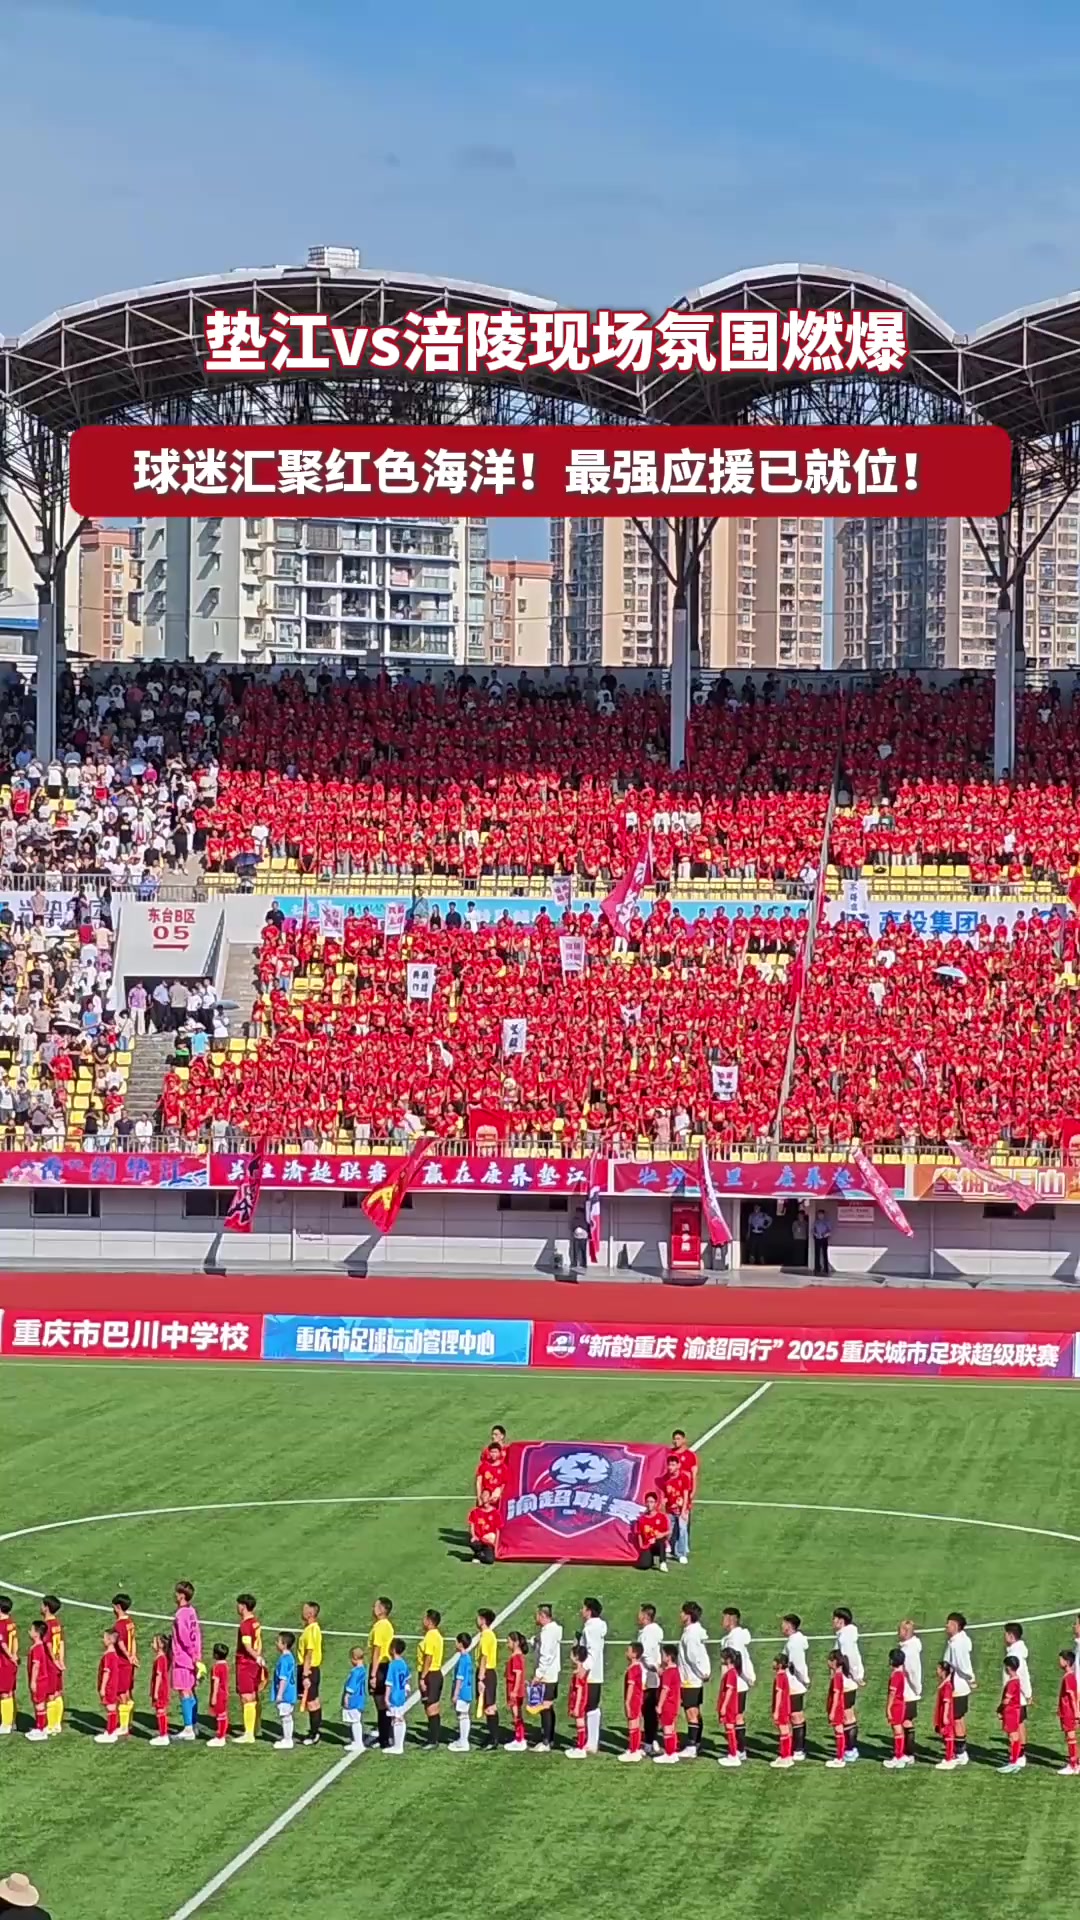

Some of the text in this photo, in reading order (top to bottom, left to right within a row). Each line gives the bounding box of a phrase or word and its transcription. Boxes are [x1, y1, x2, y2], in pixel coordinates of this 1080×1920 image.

[148, 907, 196, 924] 东台B区
[153, 926, 190, 939] 05
[12, 1318, 250, 1352] 重庆市巴川中学校
[295, 1325, 495, 1356] 重庆市足球运动管理中心
[506, 1488, 648, 1525] 渝超联赛
